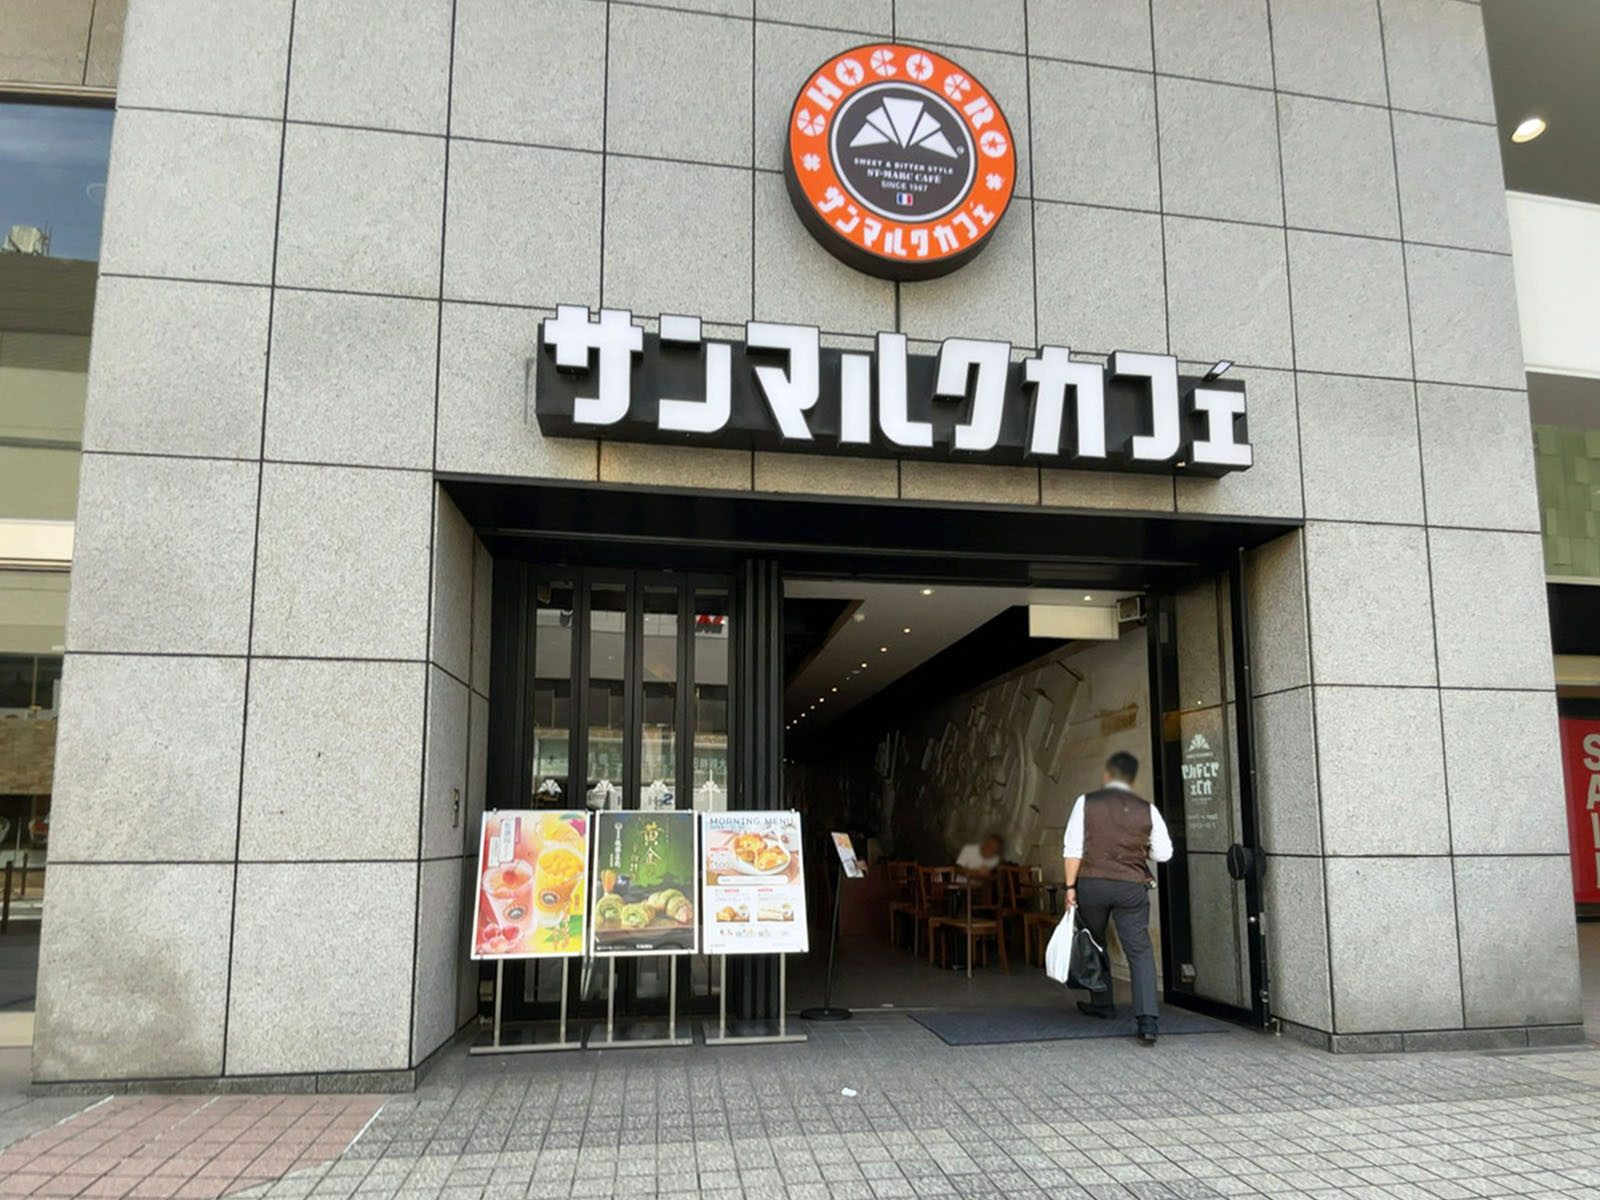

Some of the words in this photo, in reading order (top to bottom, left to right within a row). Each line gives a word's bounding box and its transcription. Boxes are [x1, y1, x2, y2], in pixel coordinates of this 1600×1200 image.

[797, 49, 934, 137] CHOCO
[943, 74, 1008, 158] CRO
[854, 158, 882, 166] SWEET
[885, 160, 892, 169] &
[894, 162, 925, 172] BITTER
[927, 165, 954, 175] STYLE
[881, 180, 907, 190] SINCE
[818, 187, 994, 257] サンマルクカフェ
[543, 304, 1254, 471] サンマルクカフェ
[710, 816, 760, 825] MORNING
[764, 817, 794, 825] MENU
